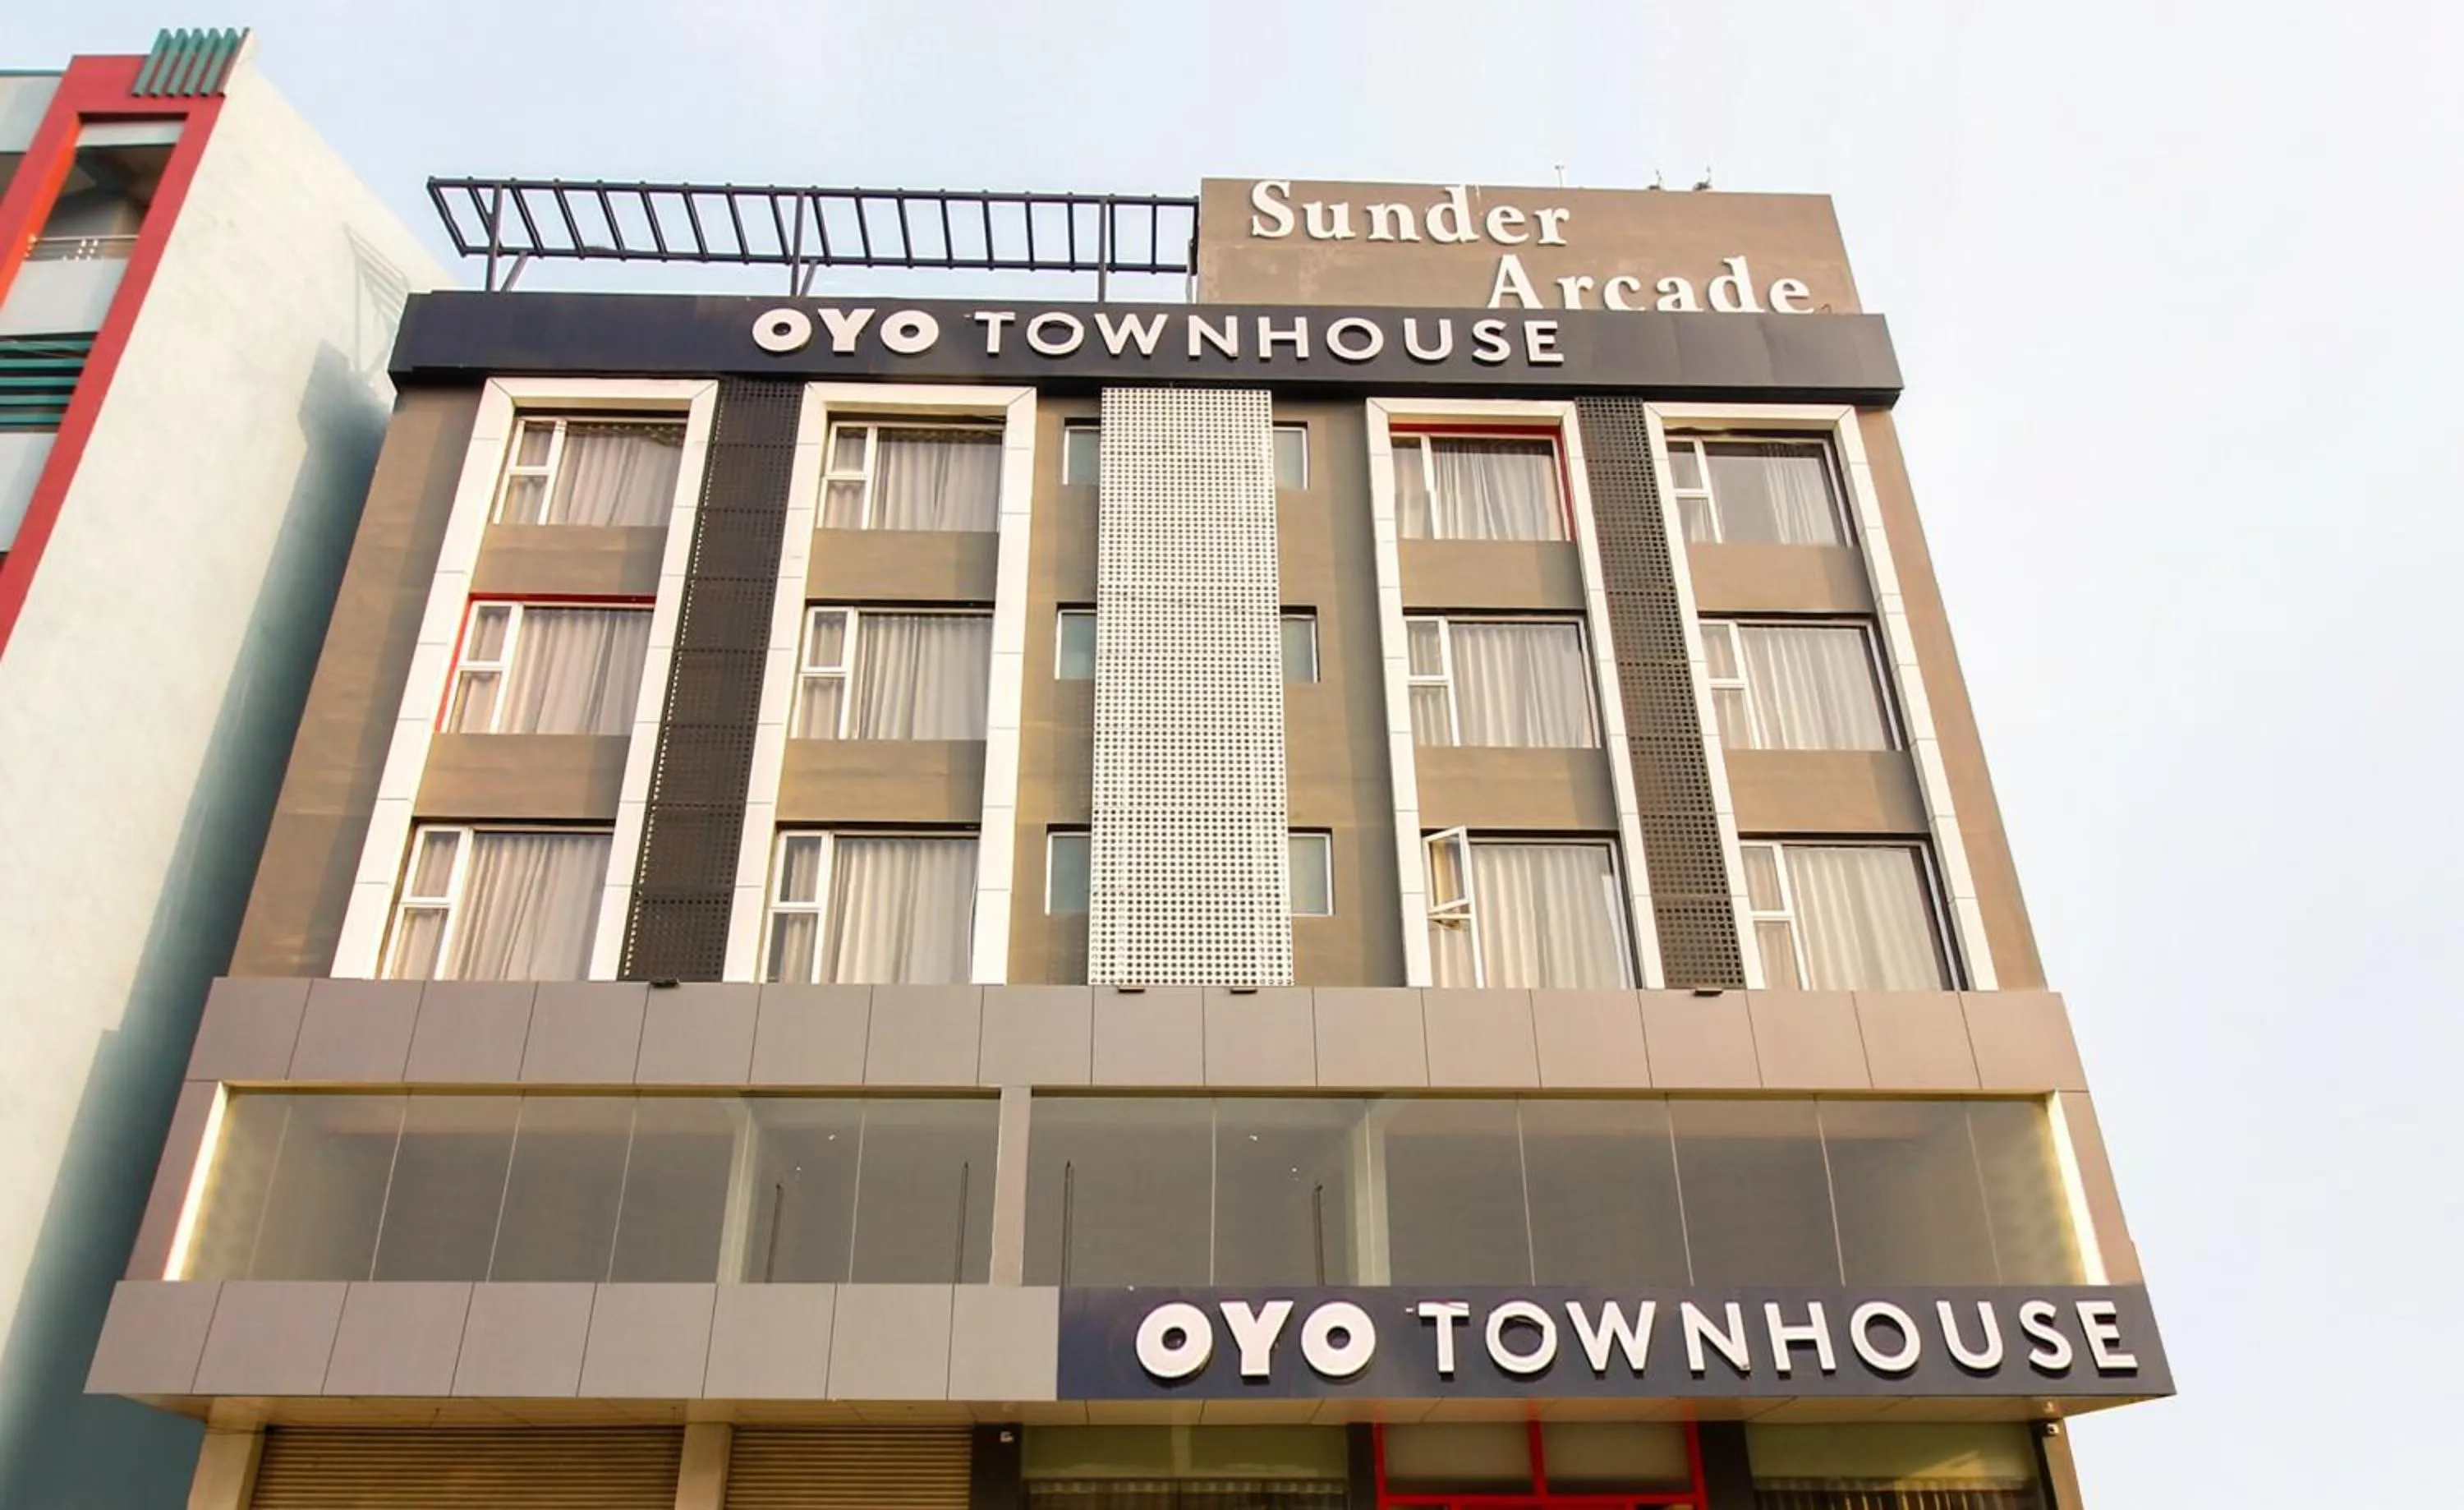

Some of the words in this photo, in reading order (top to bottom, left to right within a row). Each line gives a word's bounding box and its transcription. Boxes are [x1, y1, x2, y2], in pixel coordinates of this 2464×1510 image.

[1250, 180, 1570, 246] Sunder
[1487, 253, 1815, 315] Arcade
[751, 307, 940, 354] OYO
[973, 310, 1565, 364] TOWNHOUSE
[1134, 1301, 1377, 1379] OYO
[1418, 1300, 2140, 1375] TOWNHOUSE
